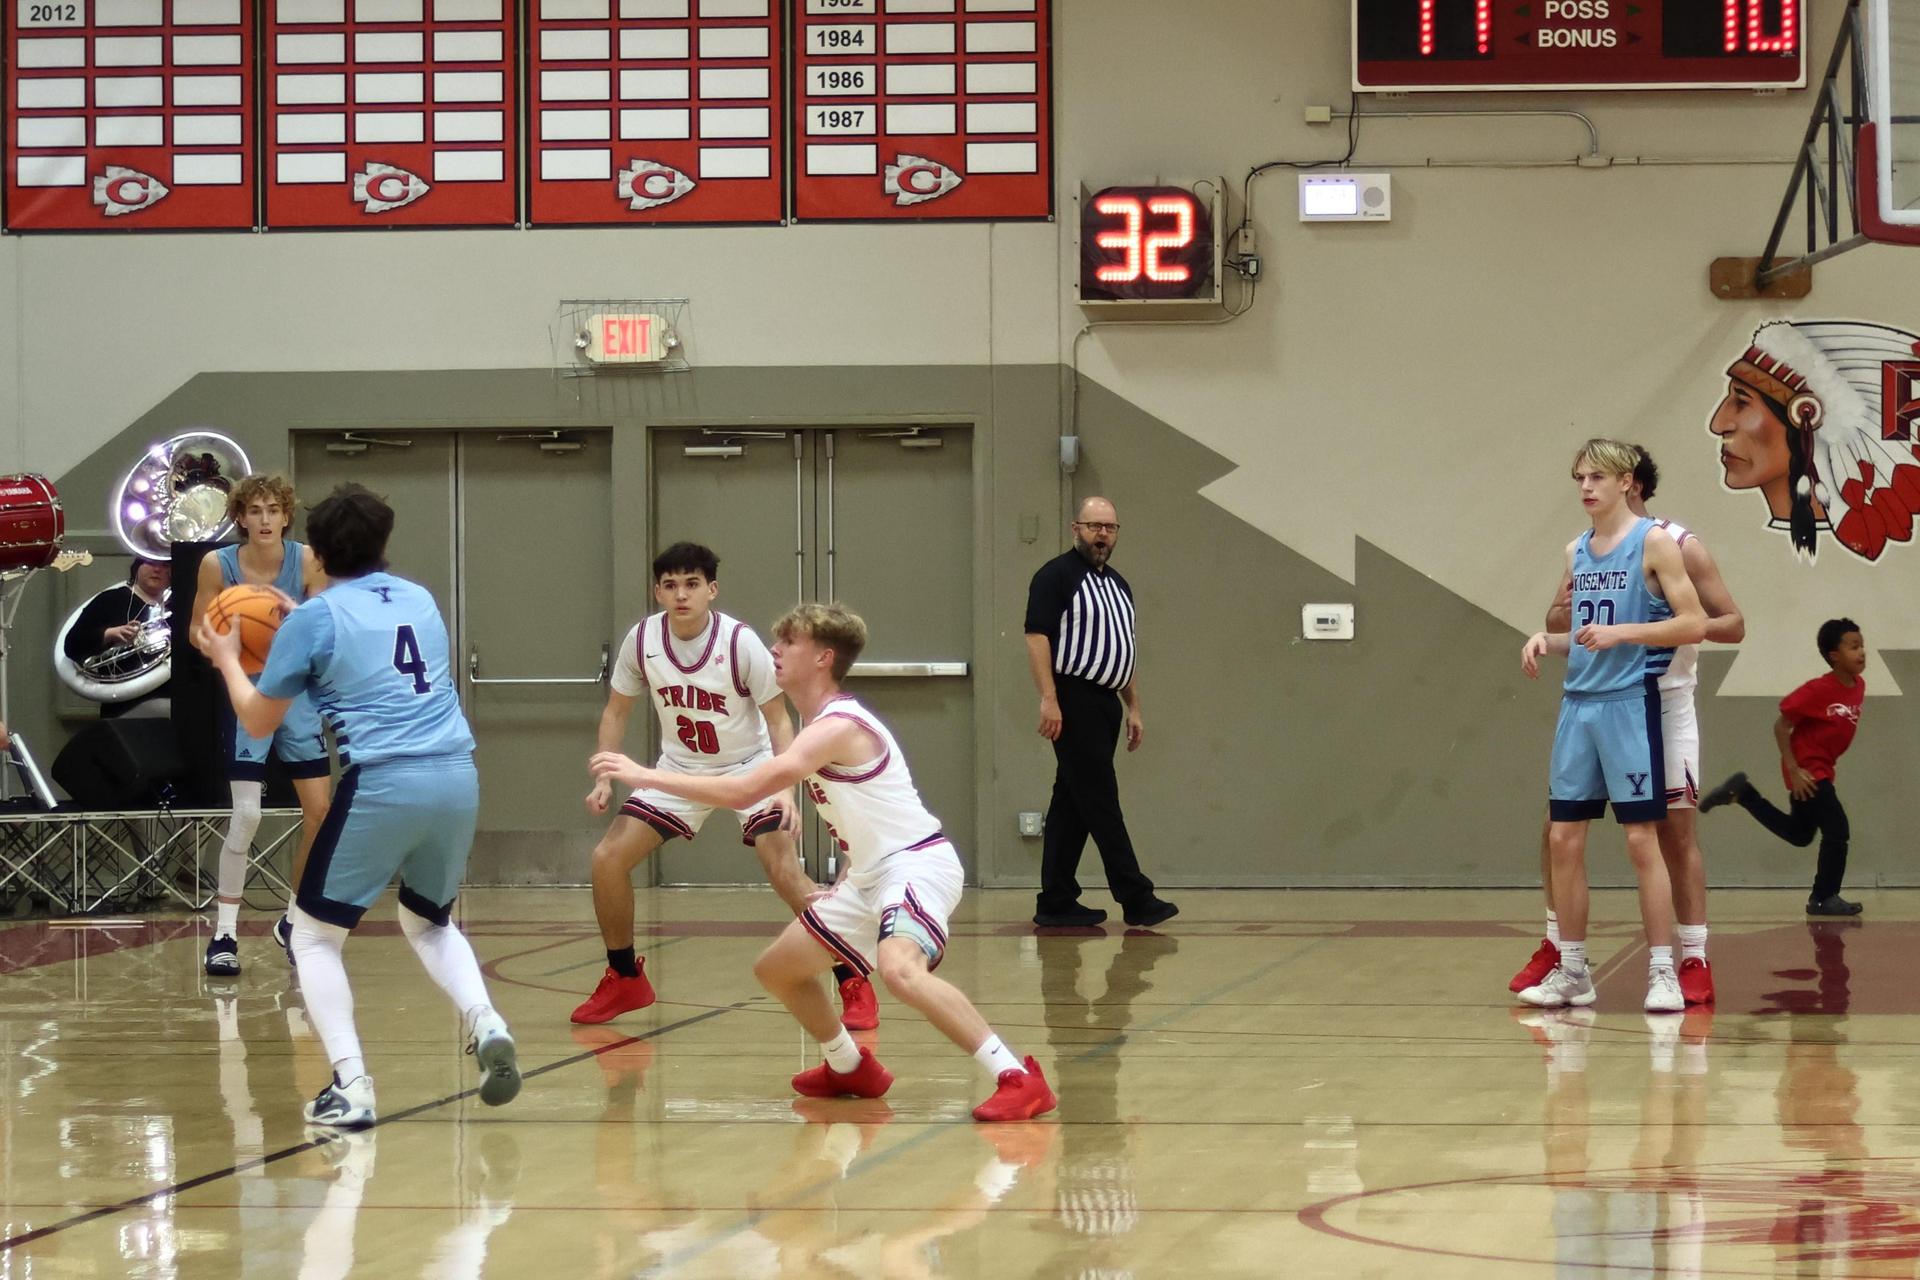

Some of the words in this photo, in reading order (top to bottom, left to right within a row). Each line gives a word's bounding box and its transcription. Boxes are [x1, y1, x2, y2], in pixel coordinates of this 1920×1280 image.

[30, 4, 76, 21] 2012
[1545, 0, 1610, 19] POSS
[817, 30, 864, 47] 1984
[1538, 28, 1618, 48] BONUS
[817, 71, 864, 88] 1986
[817, 111, 864, 128] 1987
[105, 176, 149, 205] C
[365, 172, 410, 201] C
[631, 170, 675, 199] C
[897, 165, 941, 194] C
[1096, 195, 1193, 282] 32
[604, 319, 651, 354] EXIT
[1574, 570, 1628, 592] YOSEMITE
[392, 624, 432, 696] 4
[657, 685, 730, 717] TRIBE
[676, 714, 720, 754] 20
[1624, 771, 1648, 796] Y
